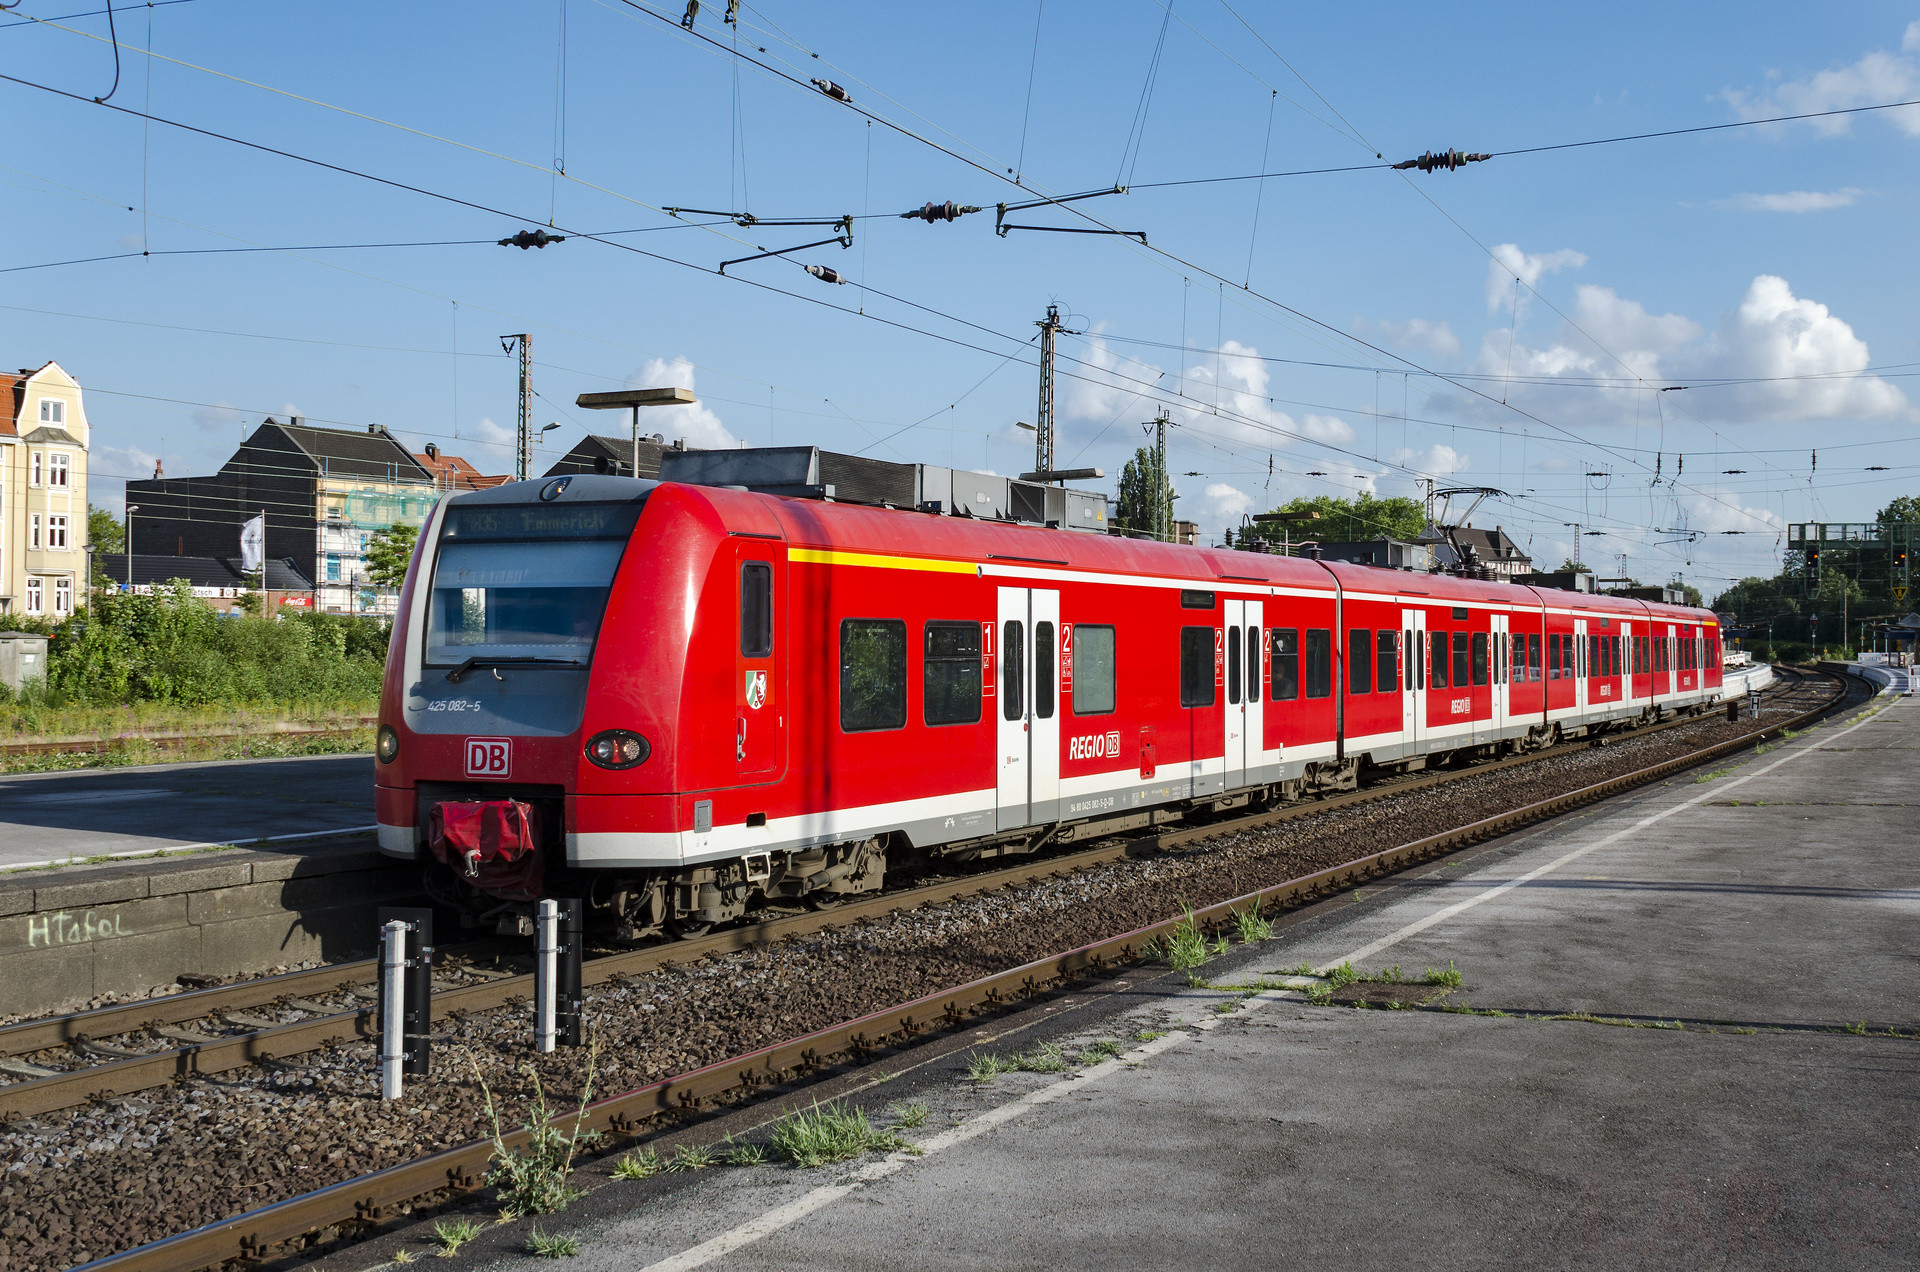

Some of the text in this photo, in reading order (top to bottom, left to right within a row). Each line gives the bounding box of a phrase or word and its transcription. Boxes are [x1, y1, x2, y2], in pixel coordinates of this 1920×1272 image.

[984, 624, 991, 653] 1
[1062, 625, 1071, 652] 2
[1216, 630, 1222, 653] 2
[1264, 630, 1270, 652] 2
[428, 700, 481, 712] 425 082-5
[1752, 697, 1760, 710] H
[469, 743, 506, 772] DB
[1070, 734, 1105, 760] REGIO
